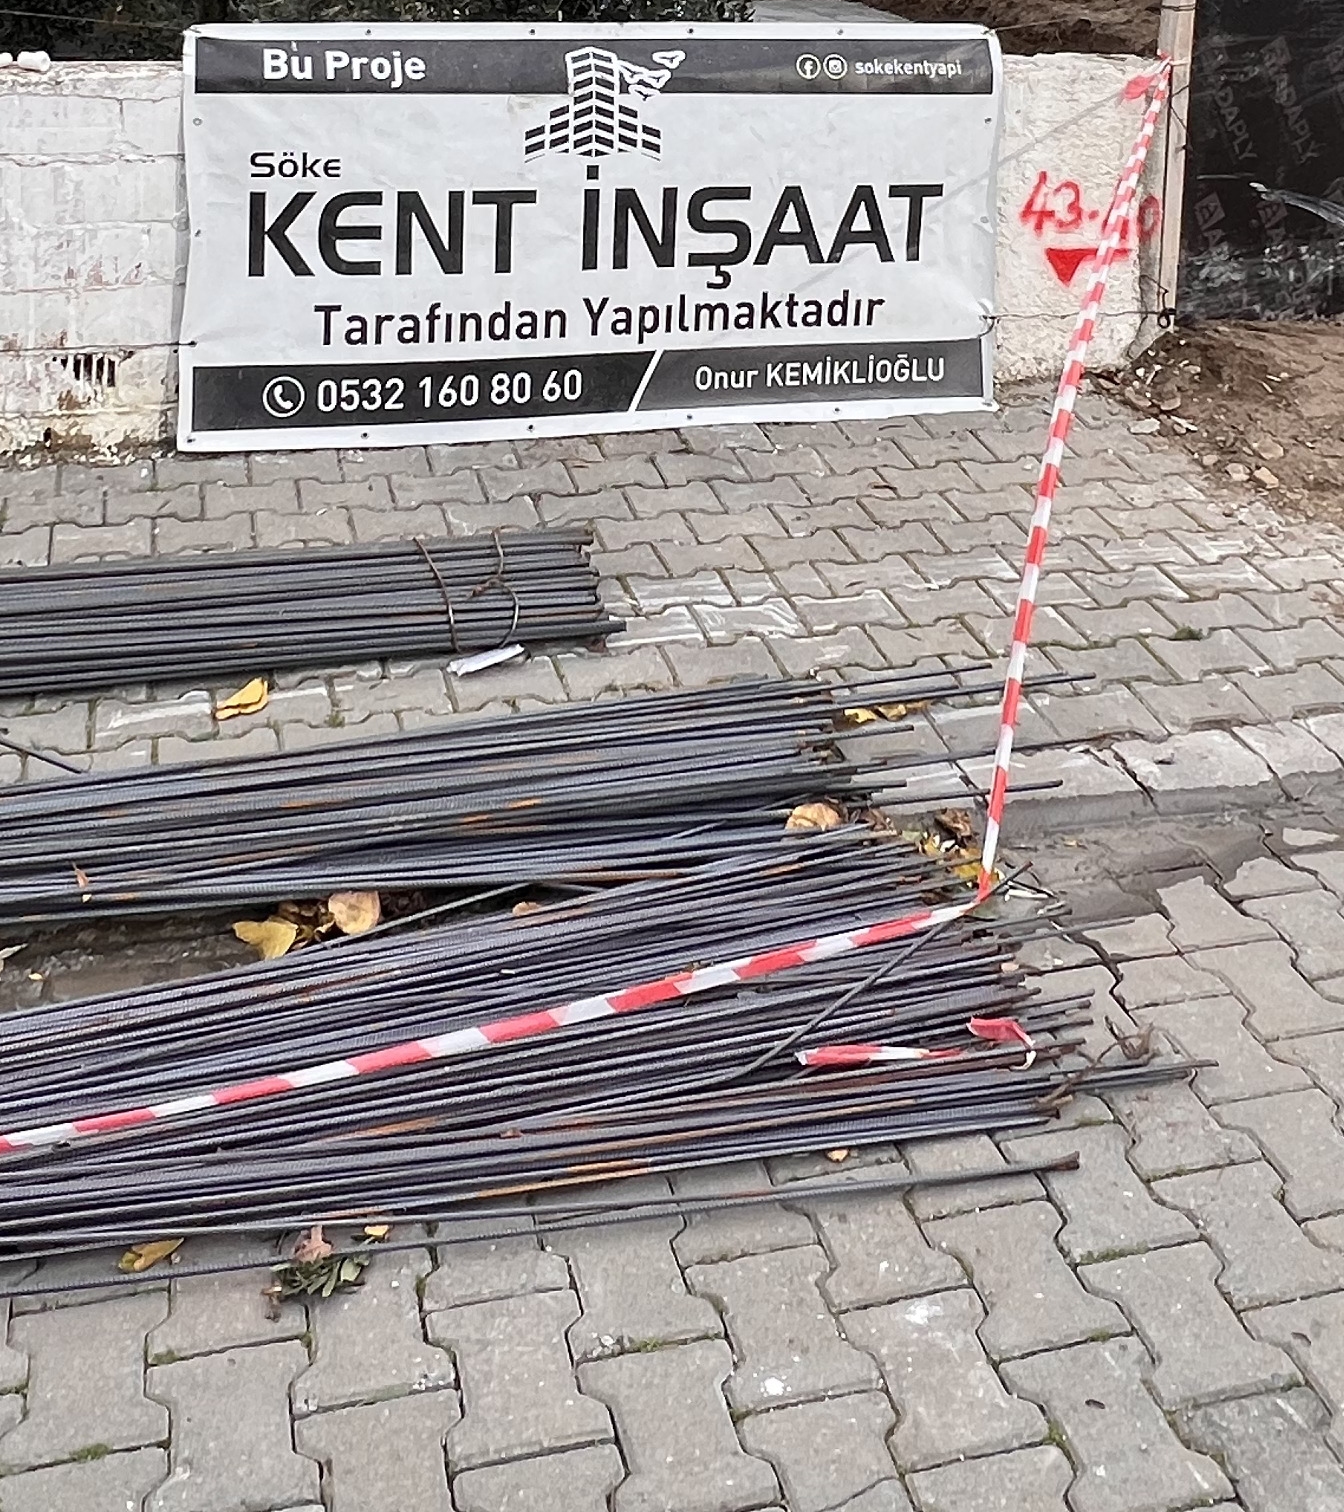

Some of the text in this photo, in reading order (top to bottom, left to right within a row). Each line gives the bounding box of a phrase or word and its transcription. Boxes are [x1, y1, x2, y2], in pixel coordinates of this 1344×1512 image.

[262, 47, 426, 89] Bu Proje
[854, 58, 962, 79] sokekentyapi
[249, 151, 342, 178] Söke
[247, 164, 944, 289] KENT İNŞAAT
[313, 289, 886, 346] Tarafından Yapılmaktadır
[316, 368, 583, 413] 0532 160 80 60
[694, 353, 945, 391] Onur KEMİKLİOĞLU
